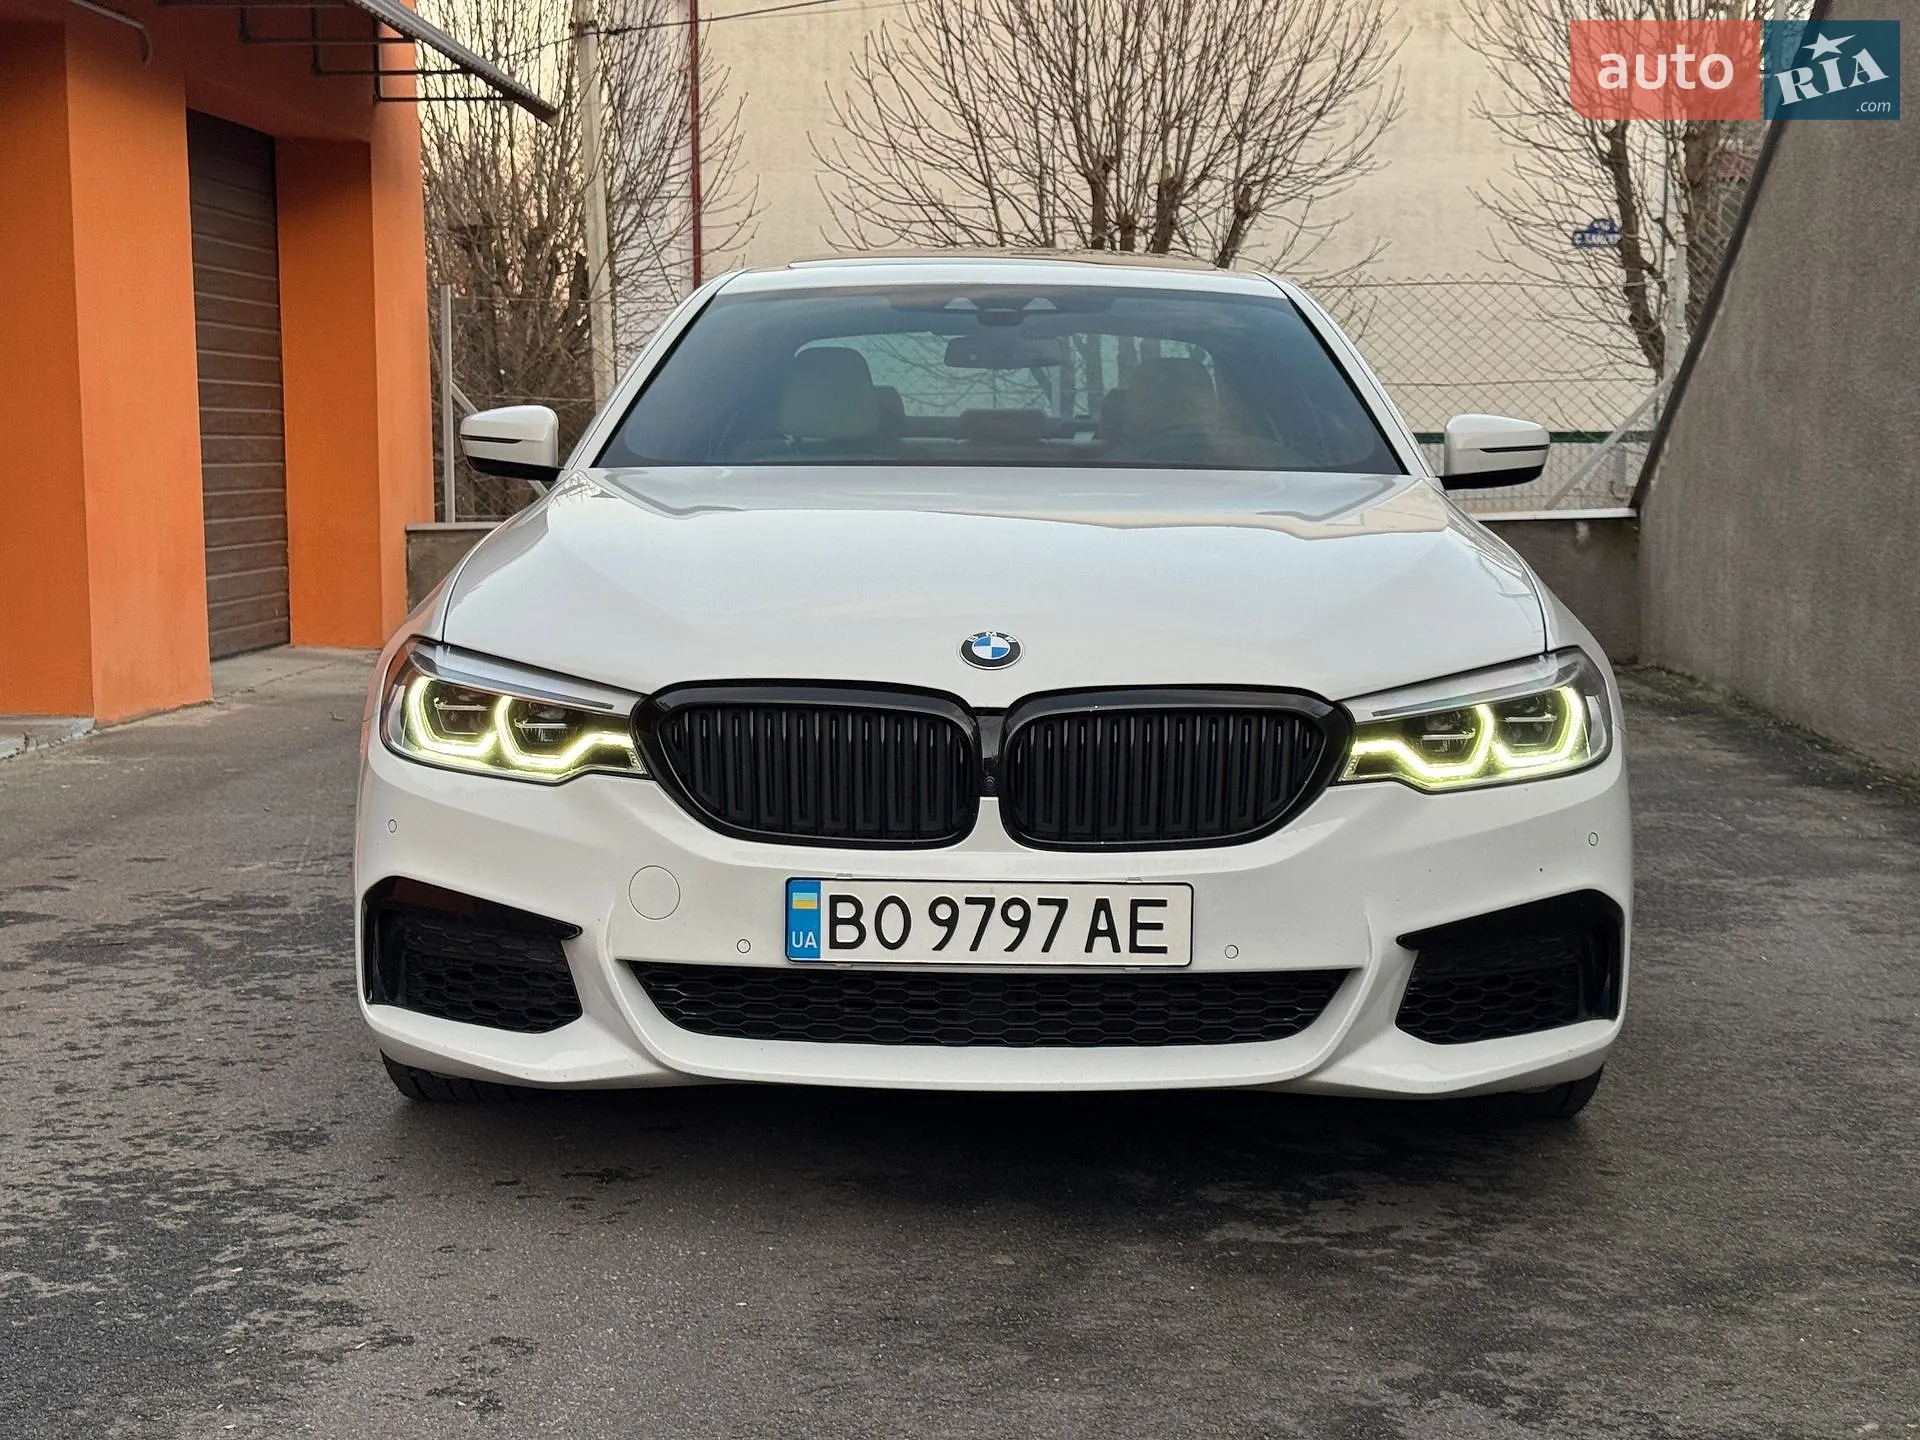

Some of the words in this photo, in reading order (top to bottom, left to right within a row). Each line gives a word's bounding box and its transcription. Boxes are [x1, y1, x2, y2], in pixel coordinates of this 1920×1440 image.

[791, 930, 818, 949] UA
[828, 894, 912, 950] BO
[928, 896, 1069, 953] 9797
[1084, 898, 1168, 953] AE
